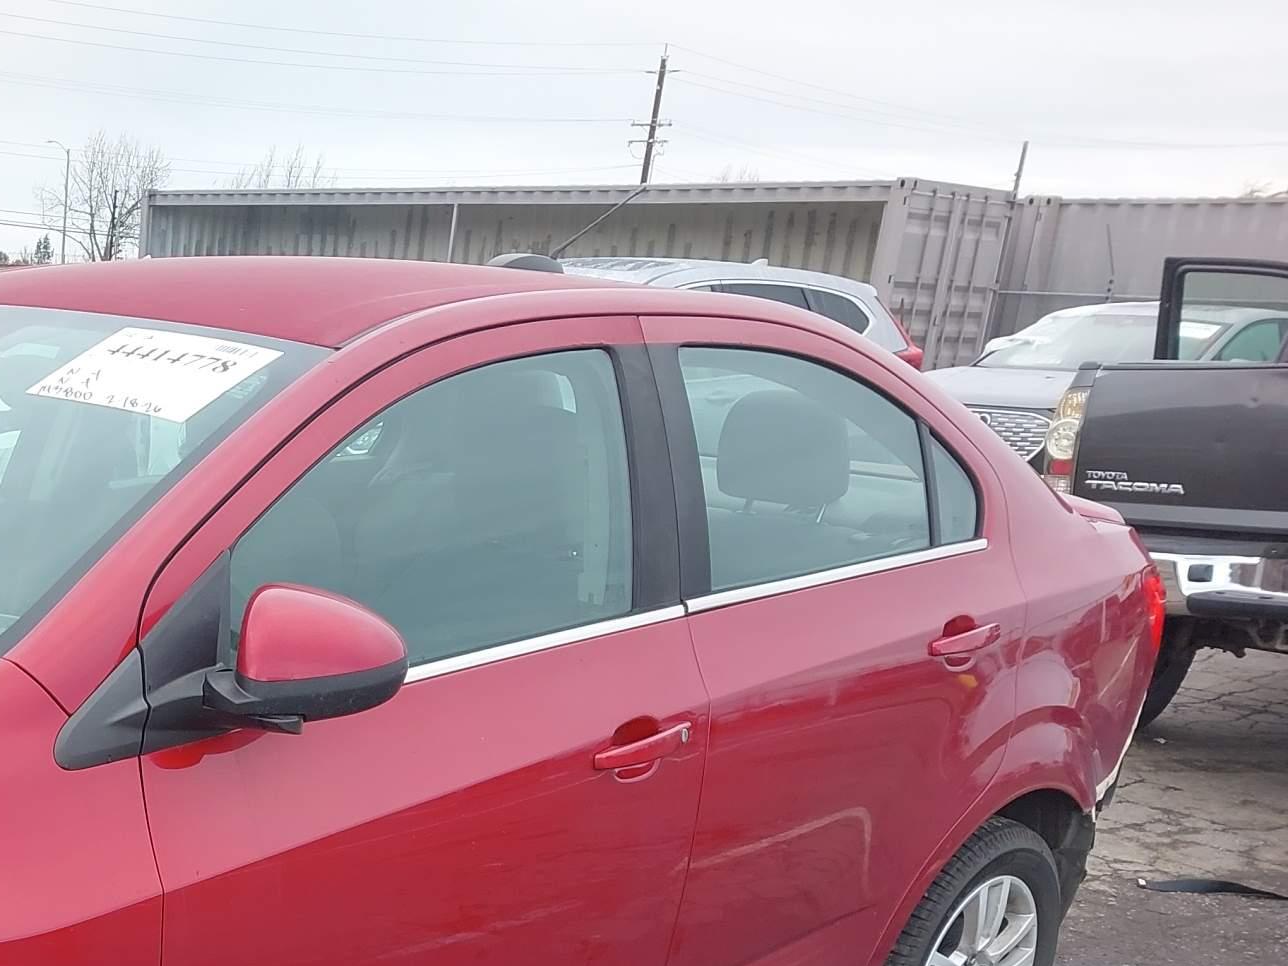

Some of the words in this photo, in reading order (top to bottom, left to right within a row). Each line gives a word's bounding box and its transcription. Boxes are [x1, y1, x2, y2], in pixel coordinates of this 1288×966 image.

[107, 344, 238, 374] 44414778
[1086, 470, 1129, 480] TOYOTA
[1085, 480, 1184, 494] TACOMA
